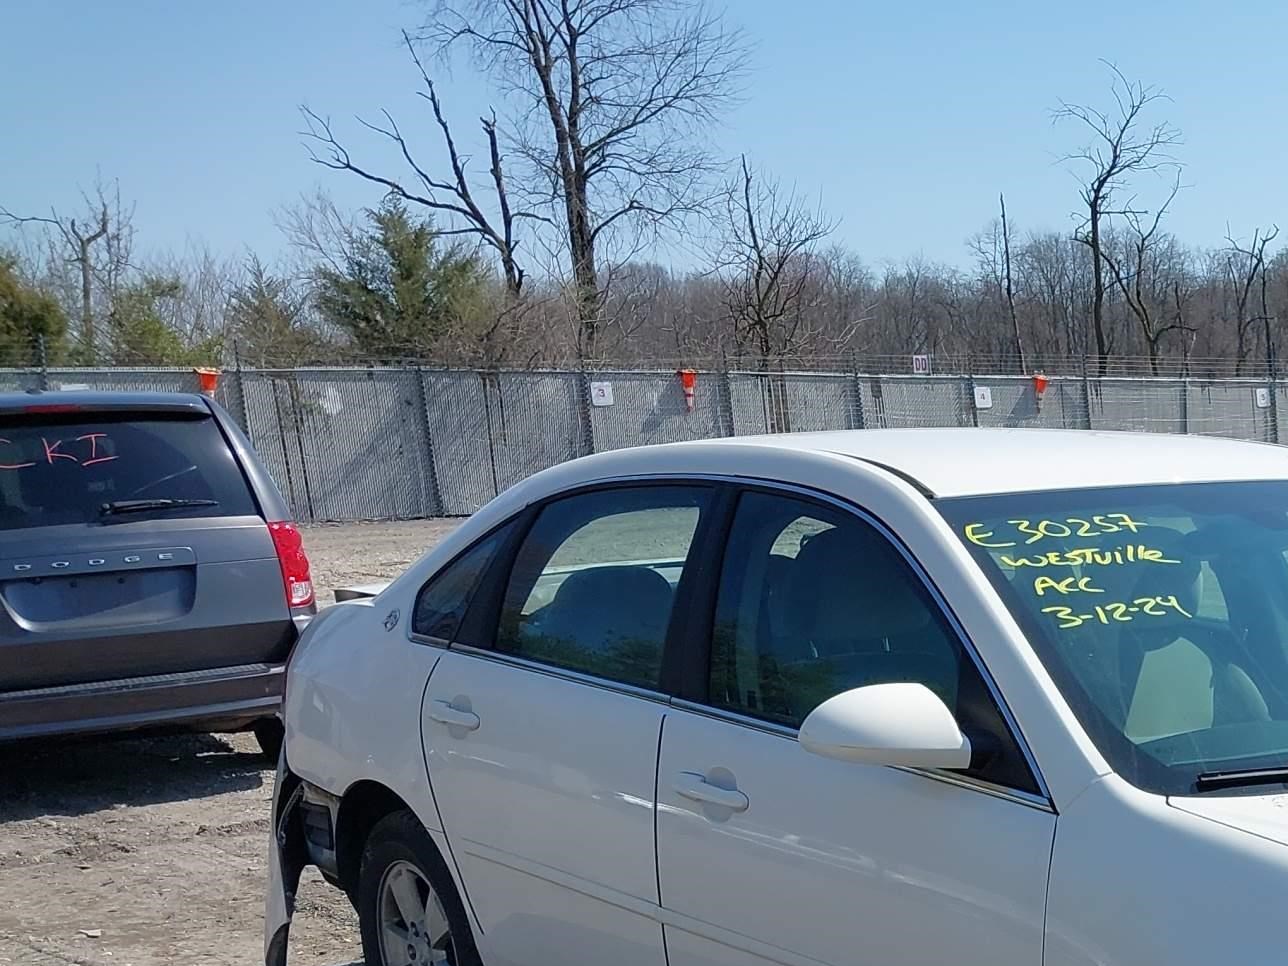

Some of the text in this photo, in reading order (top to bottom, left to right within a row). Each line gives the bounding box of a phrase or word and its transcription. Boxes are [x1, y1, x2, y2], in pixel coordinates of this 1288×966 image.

[598, 388, 606, 398] 3
[965, 513, 1148, 548] E 30257
[14, 552, 174, 572] DODGE
[1033, 576, 1105, 596] ACC
[1041, 595, 1193, 629] 3-12-24
